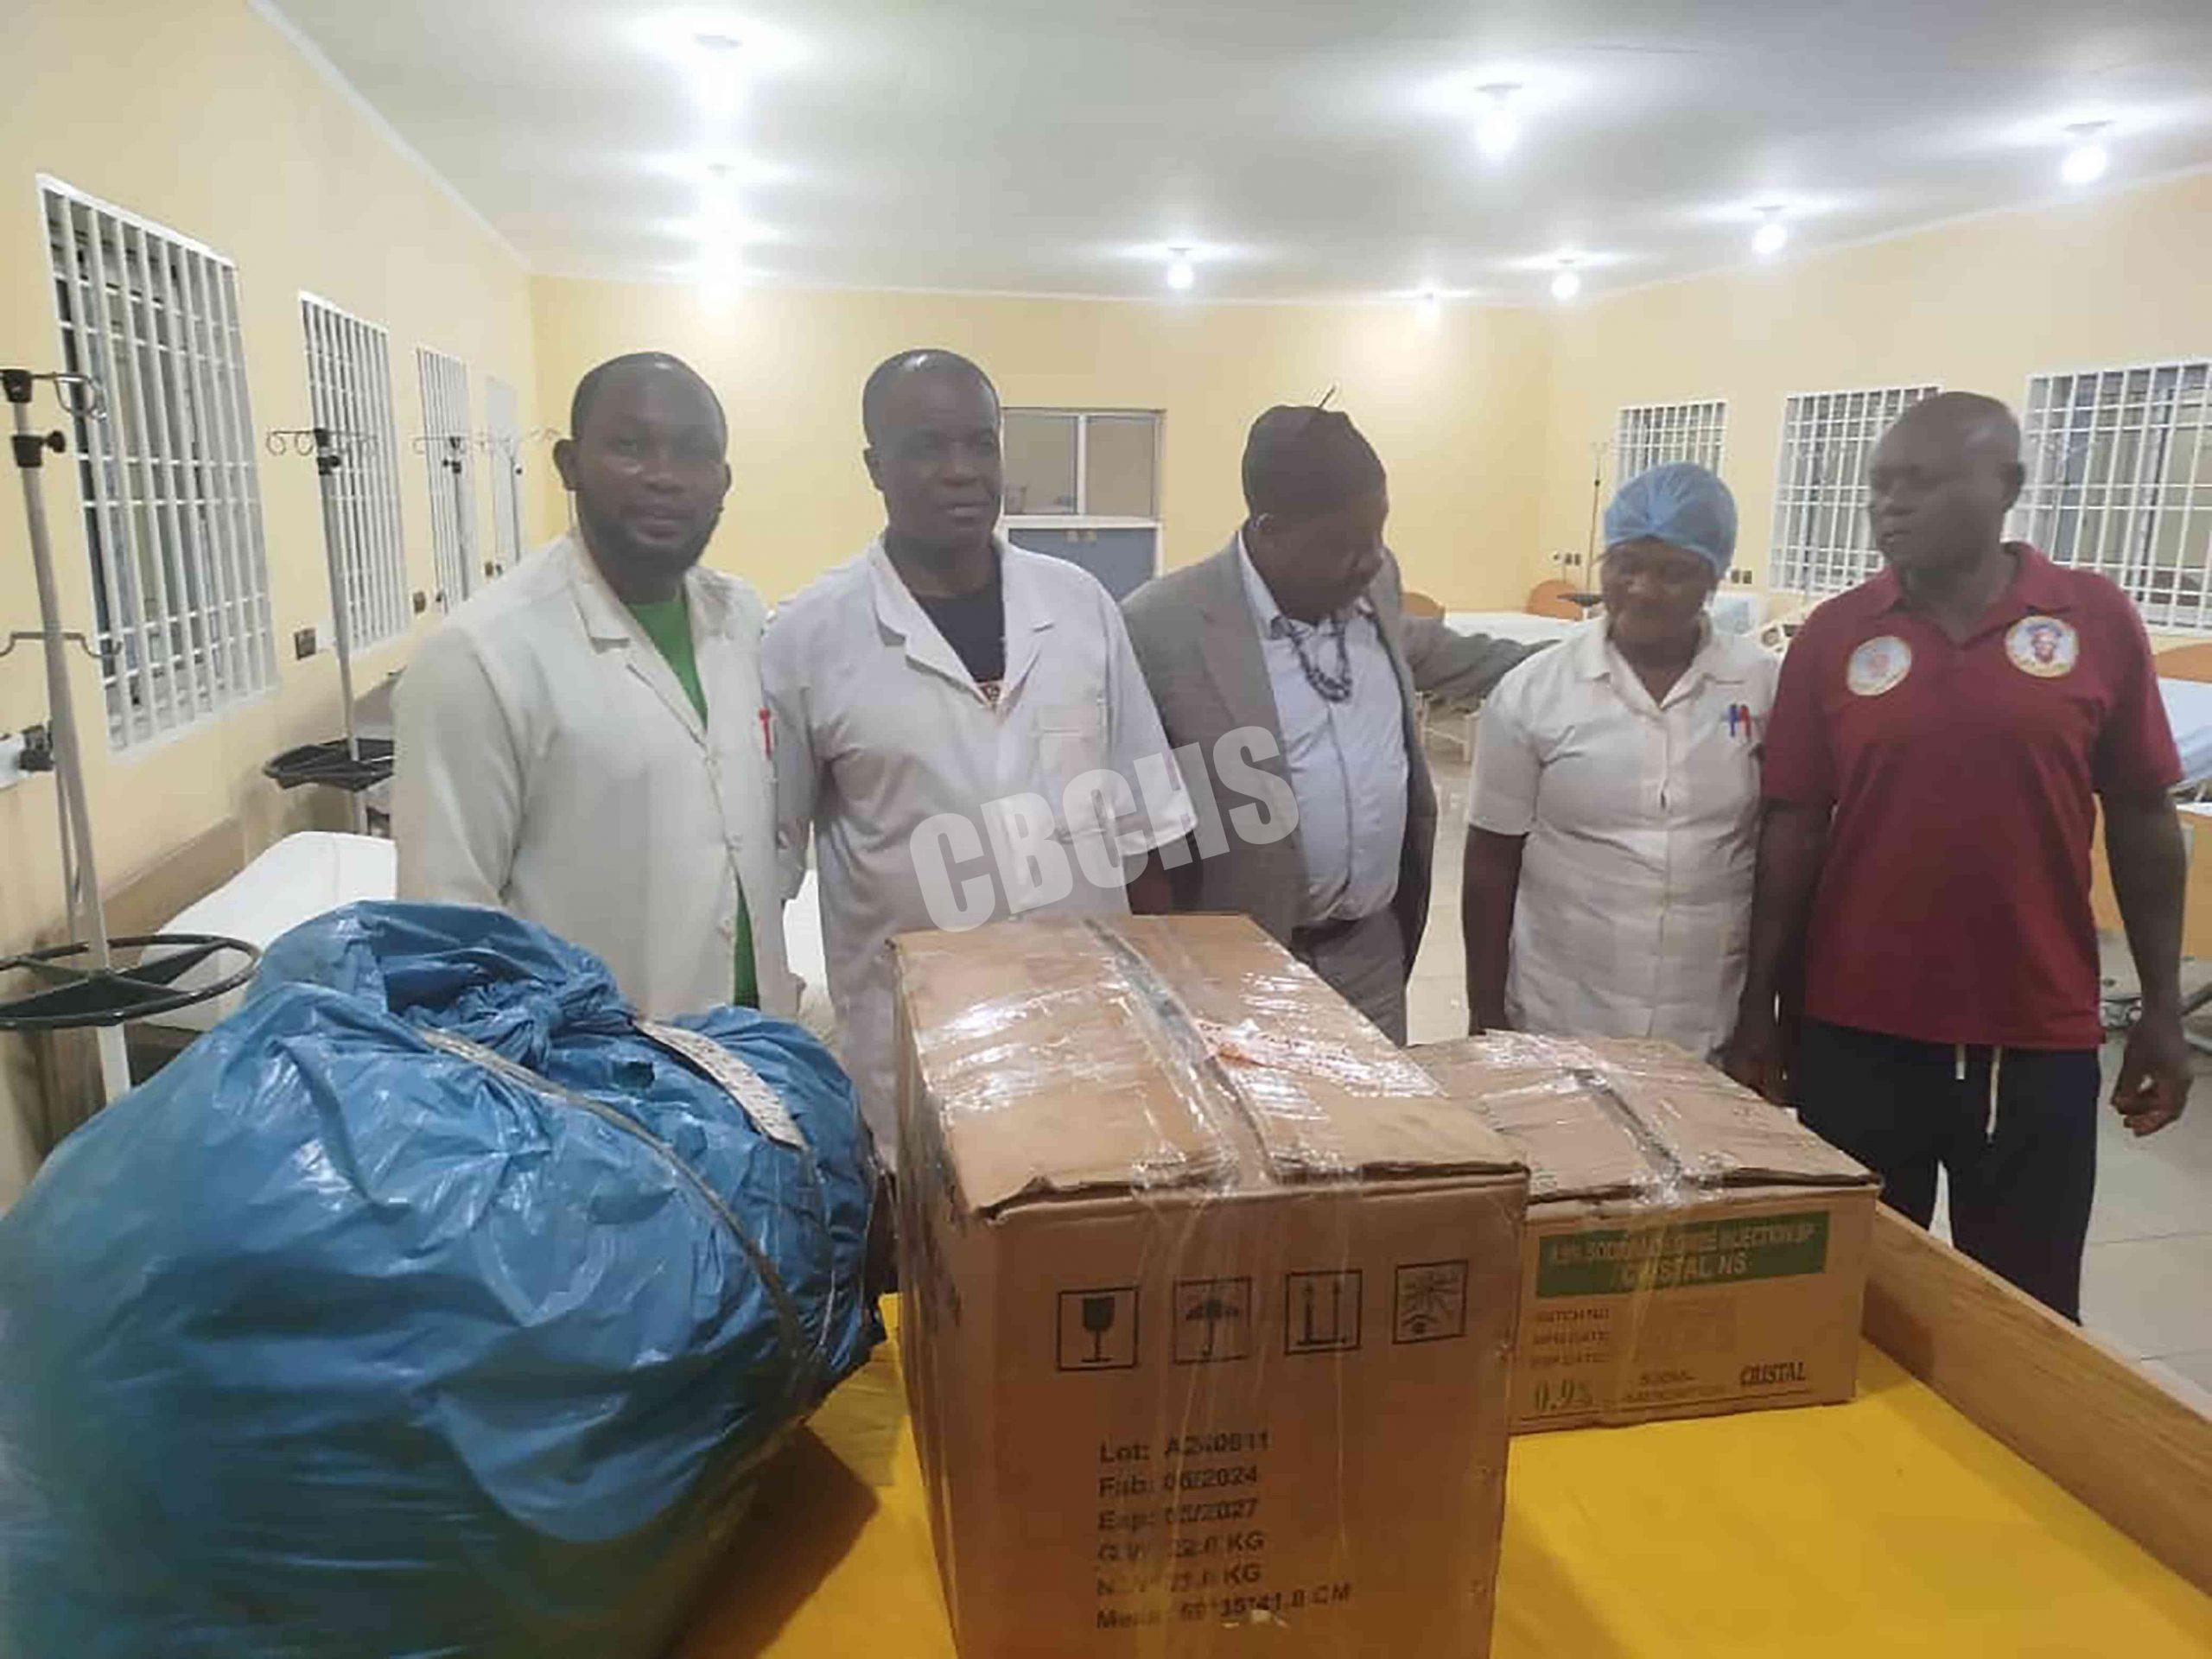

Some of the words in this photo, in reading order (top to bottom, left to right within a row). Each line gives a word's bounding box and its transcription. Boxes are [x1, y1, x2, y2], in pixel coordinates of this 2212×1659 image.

[1099, 1438, 1150, 1464] Lot:
[1227, 1529, 1265, 1553] KG
[1224, 1561, 1262, 1586] KG
